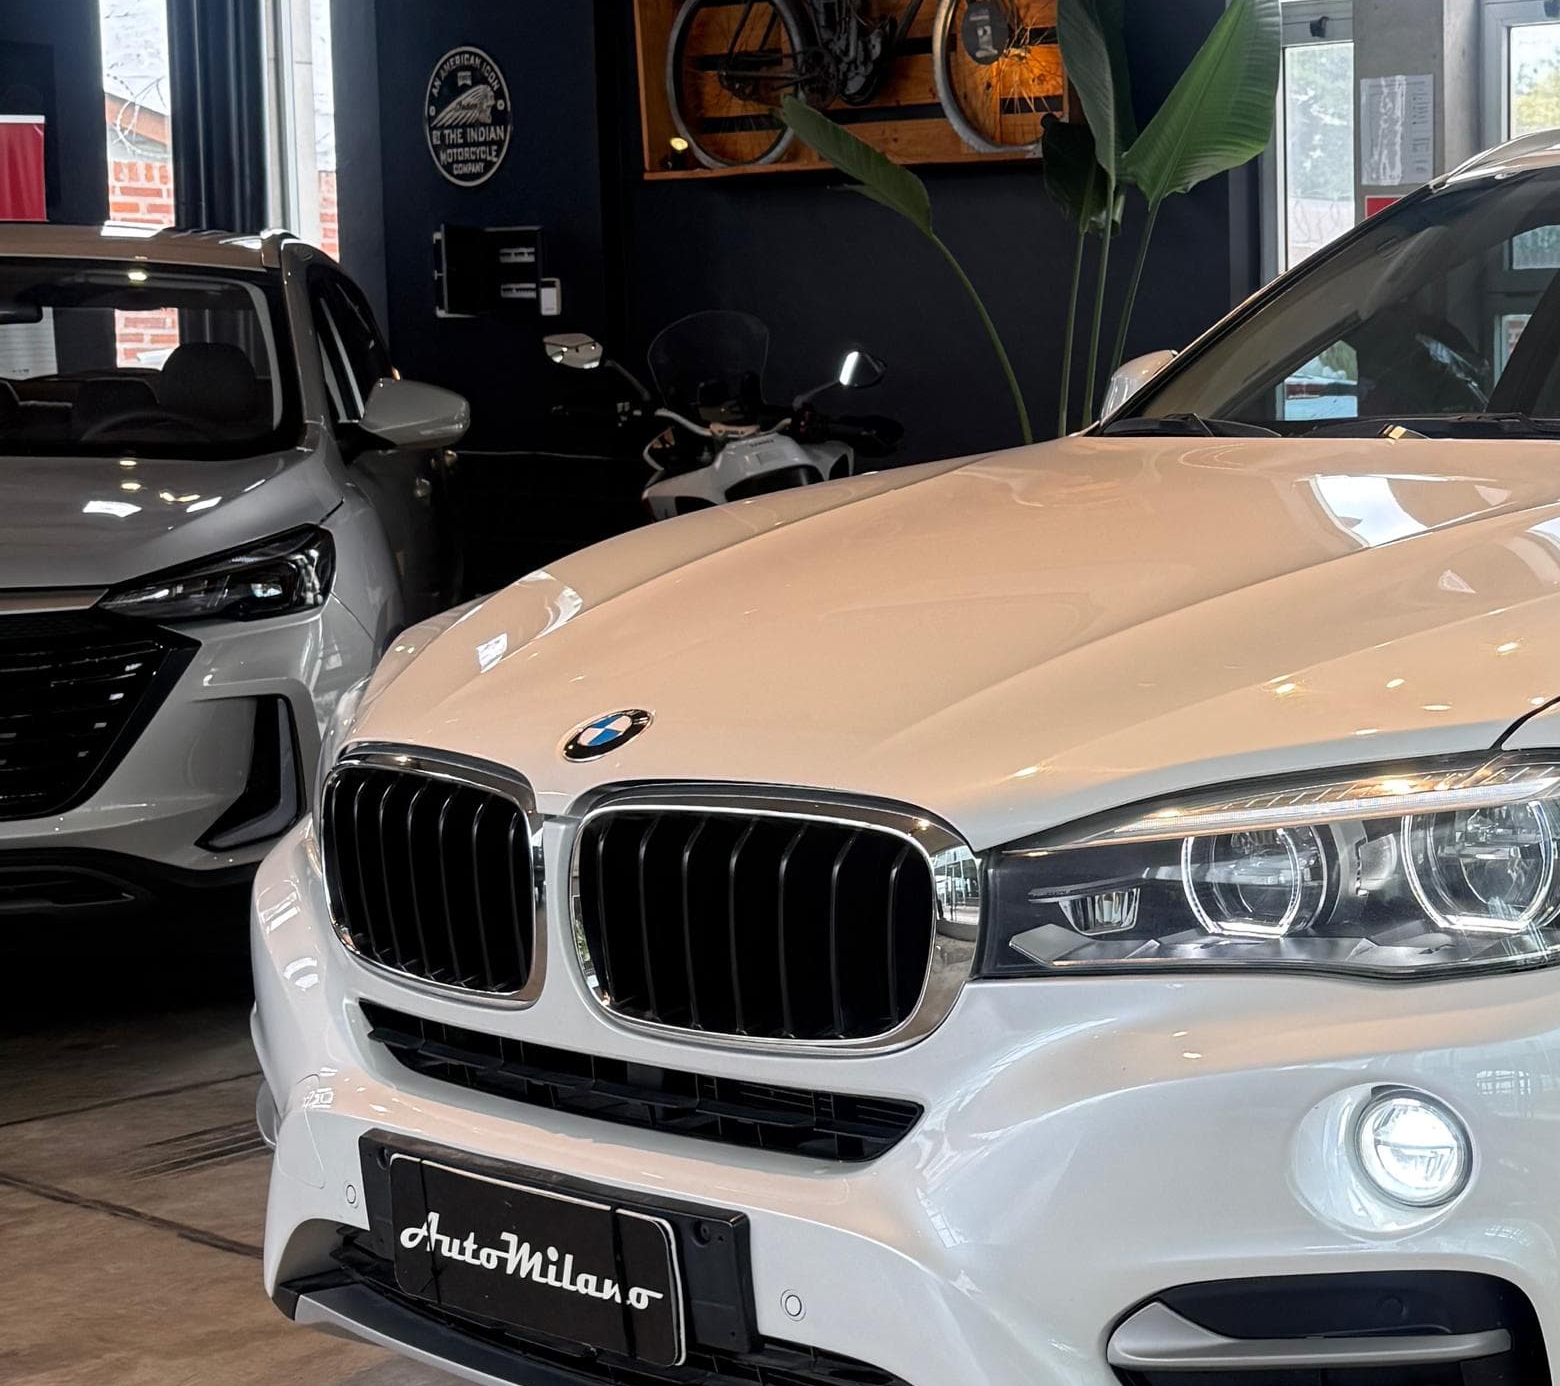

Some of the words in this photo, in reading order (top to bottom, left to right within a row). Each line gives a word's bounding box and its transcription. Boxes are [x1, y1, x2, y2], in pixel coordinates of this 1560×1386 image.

[431, 77, 442, 98] AN
[439, 53, 482, 81] AMERICAN
[481, 61, 501, 92] ICON
[443, 128, 464, 145] THE
[466, 124, 505, 143] INDIAN
[439, 144, 499, 165] MOTORCYCLE
[452, 162, 484, 175] COMPANY
[400, 1210, 665, 1311] AutoMilano
